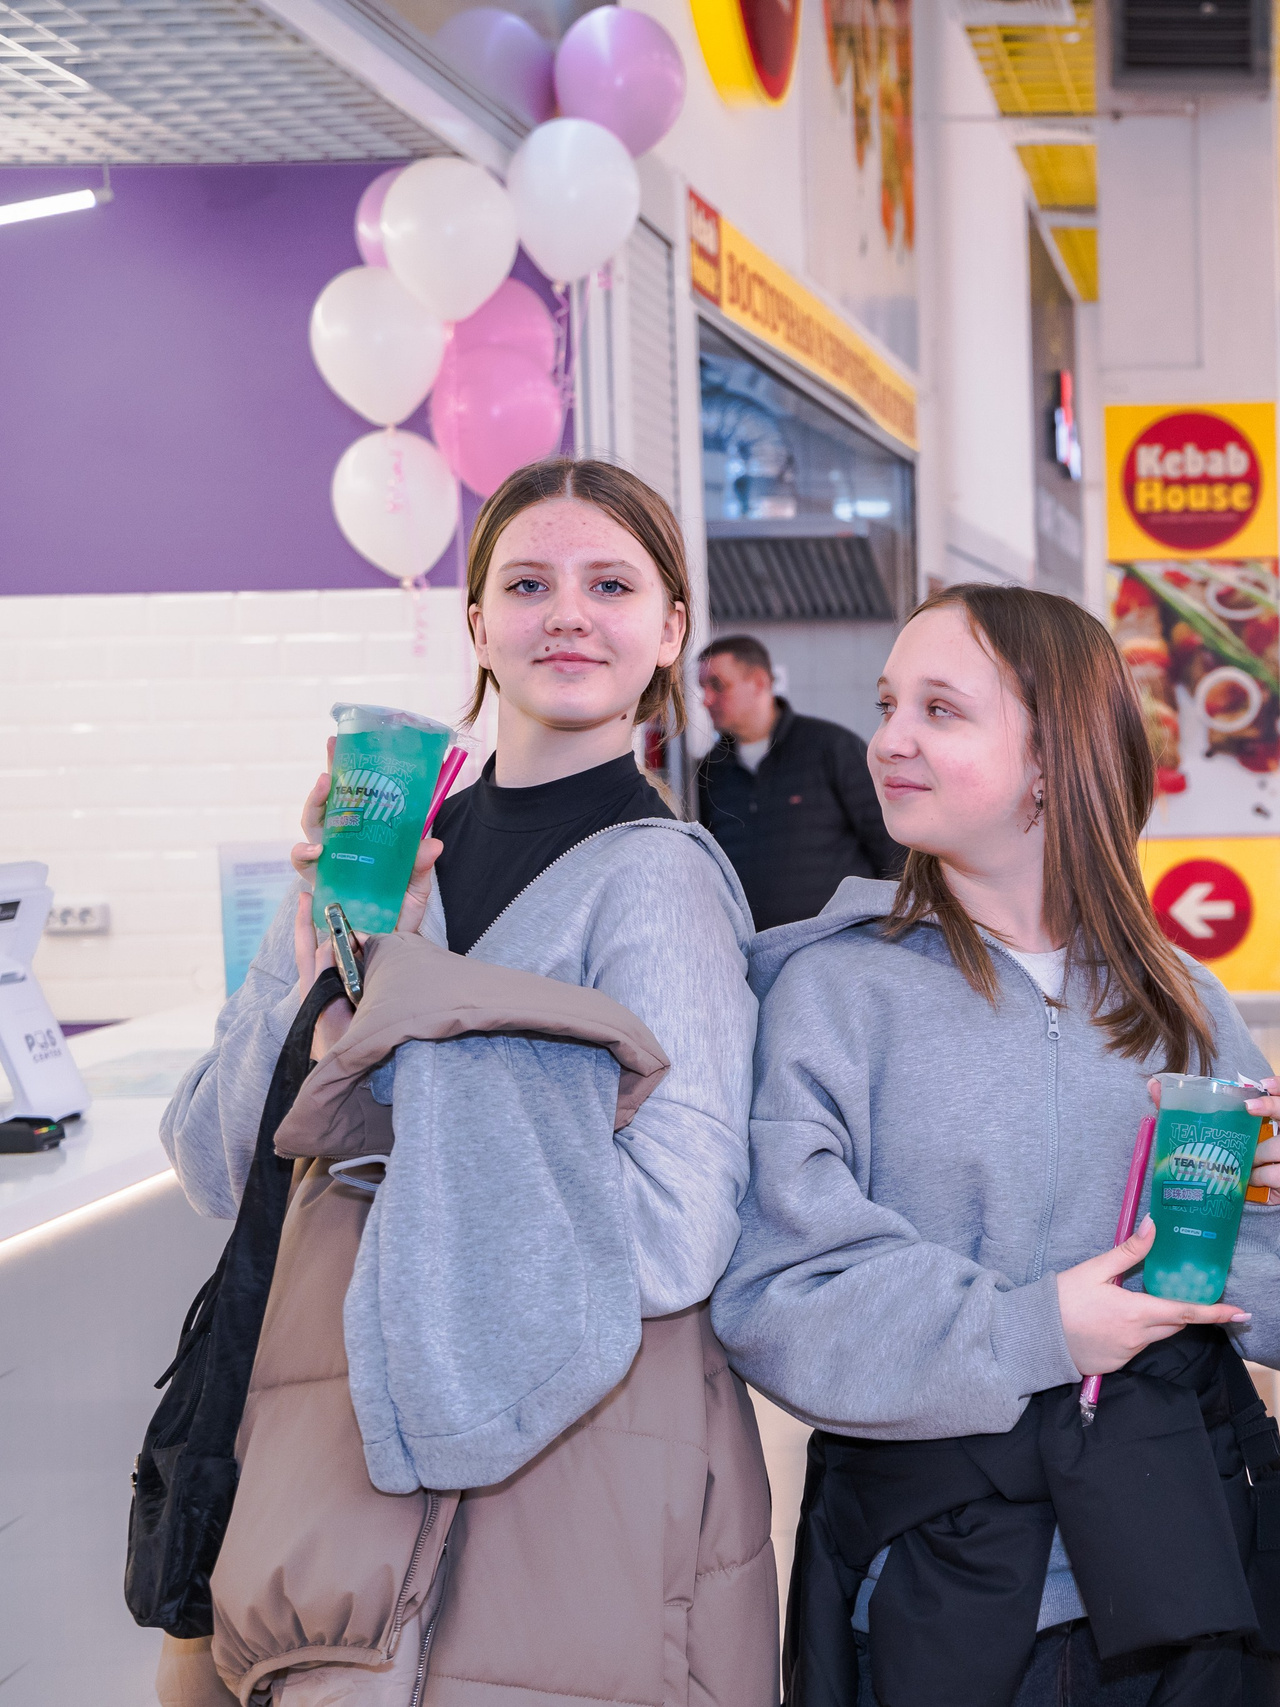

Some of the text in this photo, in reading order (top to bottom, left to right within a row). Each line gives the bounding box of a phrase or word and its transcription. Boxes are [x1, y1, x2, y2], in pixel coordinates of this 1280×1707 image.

[1135, 441, 1250, 479] Kebab
[1134, 478, 1252, 513] House
[335, 786, 399, 802] TEA FUNNY
[1171, 1122, 1251, 1145] TEA FUNNY
[1174, 1157, 1195, 1169] TEA
[1198, 1160, 1238, 1176] FUNNY
